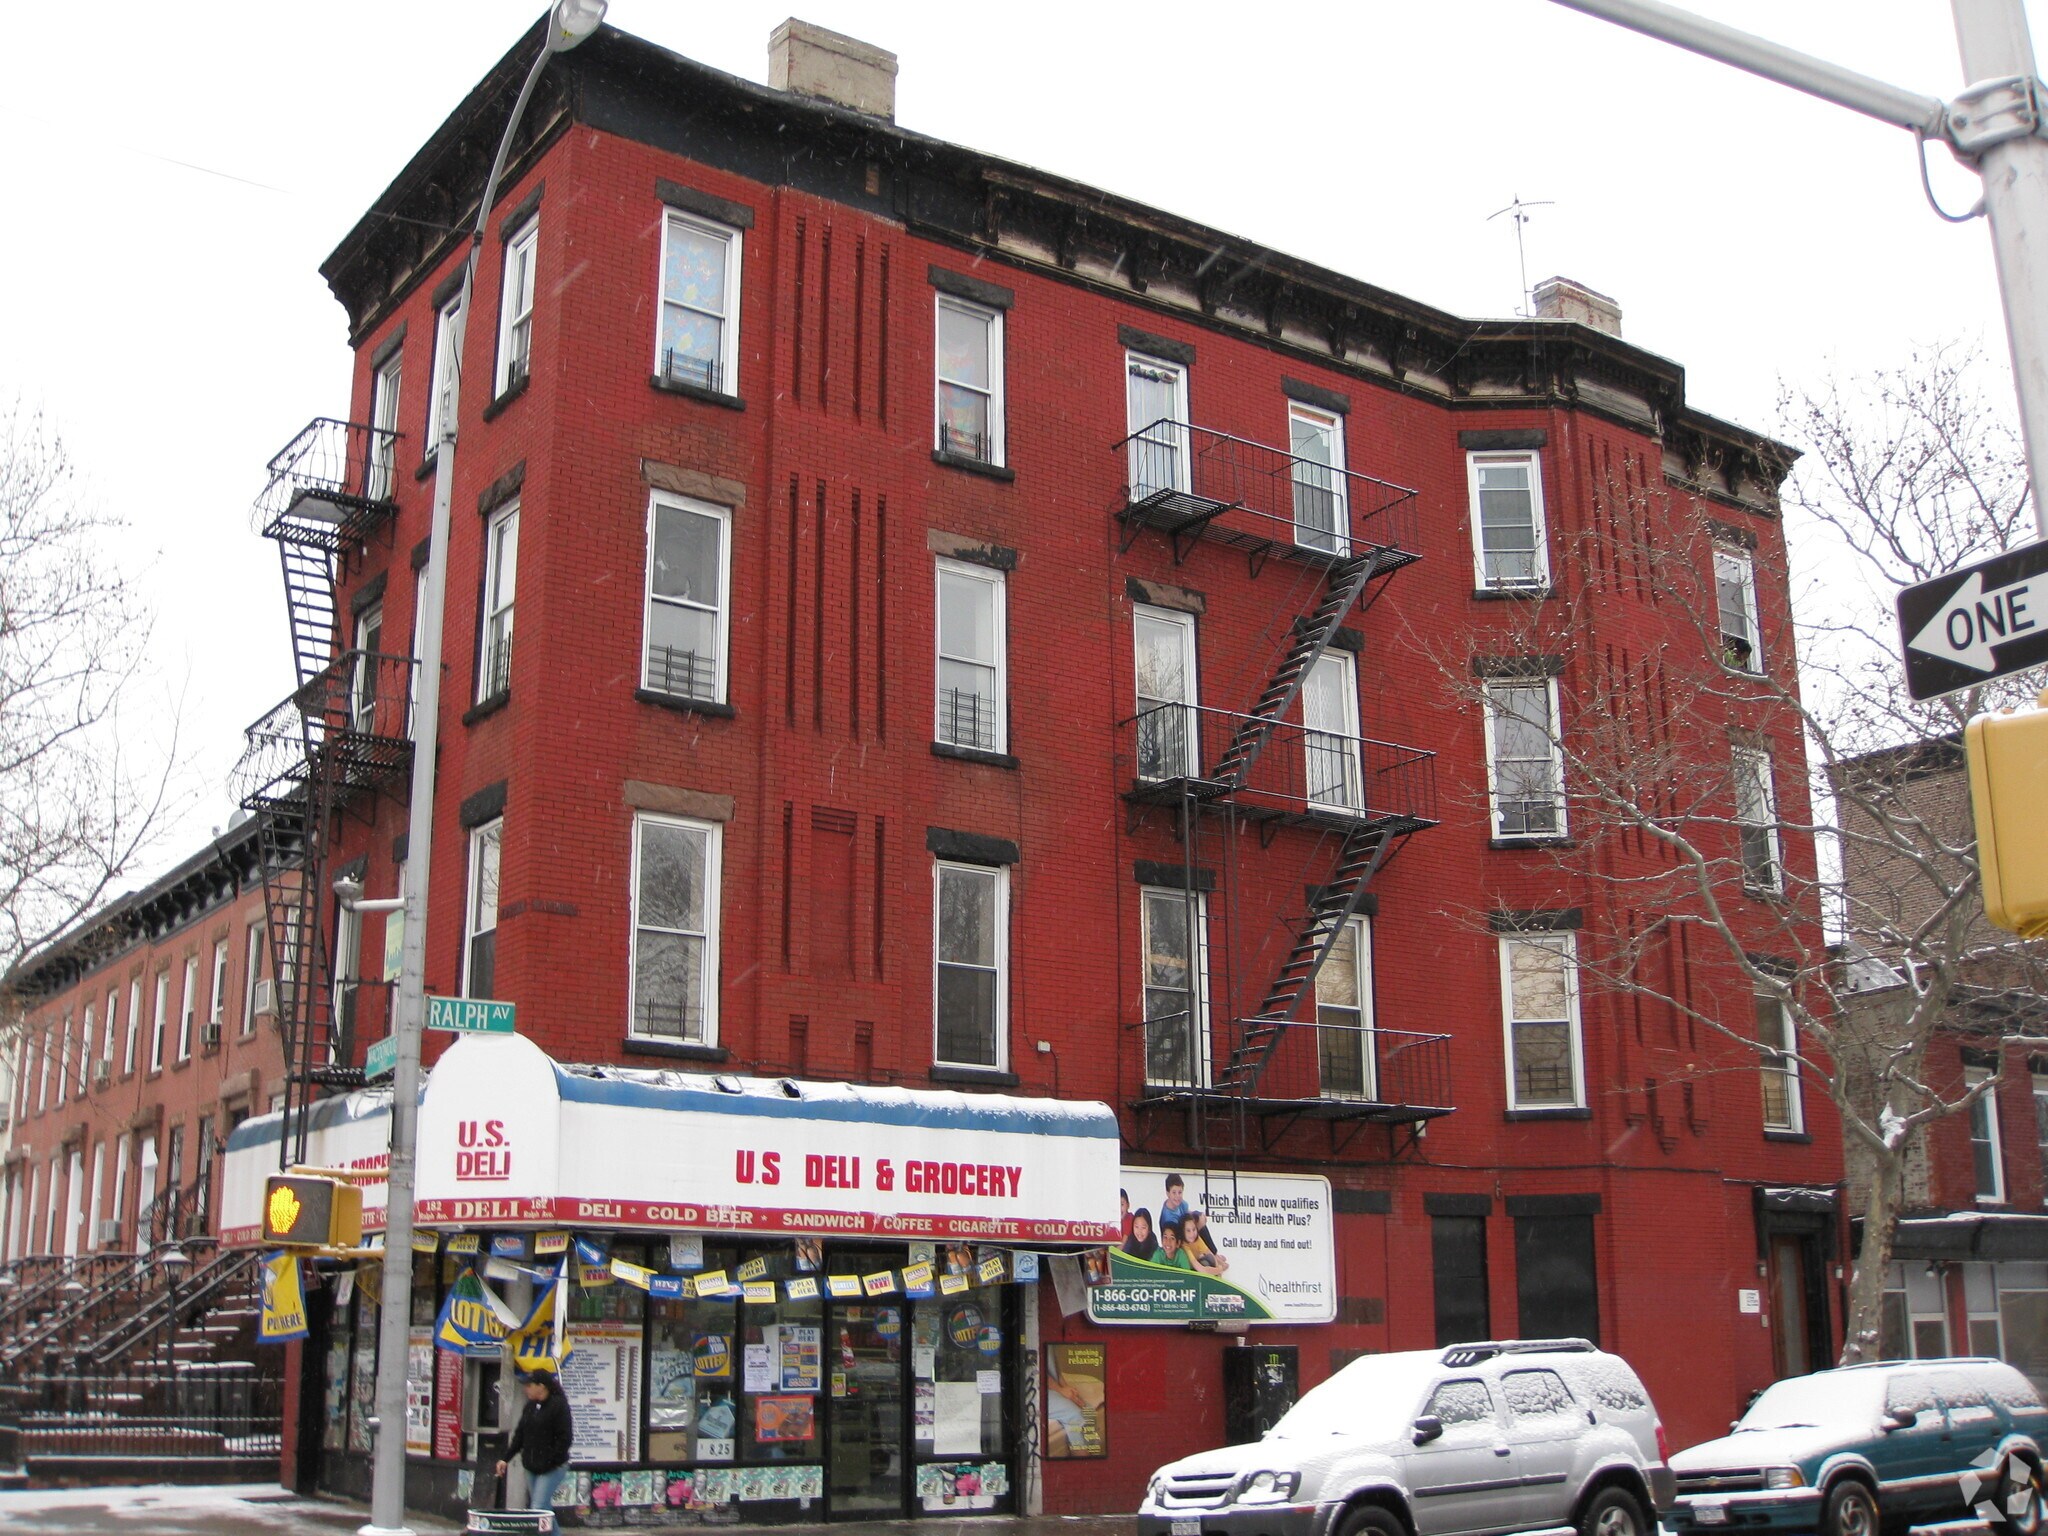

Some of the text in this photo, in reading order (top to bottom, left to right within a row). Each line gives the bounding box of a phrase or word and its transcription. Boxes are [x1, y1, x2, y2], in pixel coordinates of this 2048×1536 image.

[1946, 586, 2035, 651] ONE
[430, 1001, 510, 1029] RALPH AV
[458, 1120, 510, 1147] U.S.
[456, 1151, 511, 1176] DELI
[736, 1150, 1022, 1198] U.S DELI & GROCERY
[454, 1200, 519, 1219] DELI
[1199, 1193, 1230, 1206] Which
[1258, 1199, 1278, 1208] now
[1280, 1197, 1319, 1211] qualifies
[578, 1202, 1104, 1237] DELI COLD BEER SANDWICH COFFEE CIGARETTE COLD CUTS
[1211, 1211, 1312, 1226] for Child Health Plus?
[1222, 1237, 1312, 1250] Call today and find out!
[1093, 1288, 1196, 1302] 1-866-GO-FOR-HF
[1269, 1281, 1322, 1293] healthfirst
